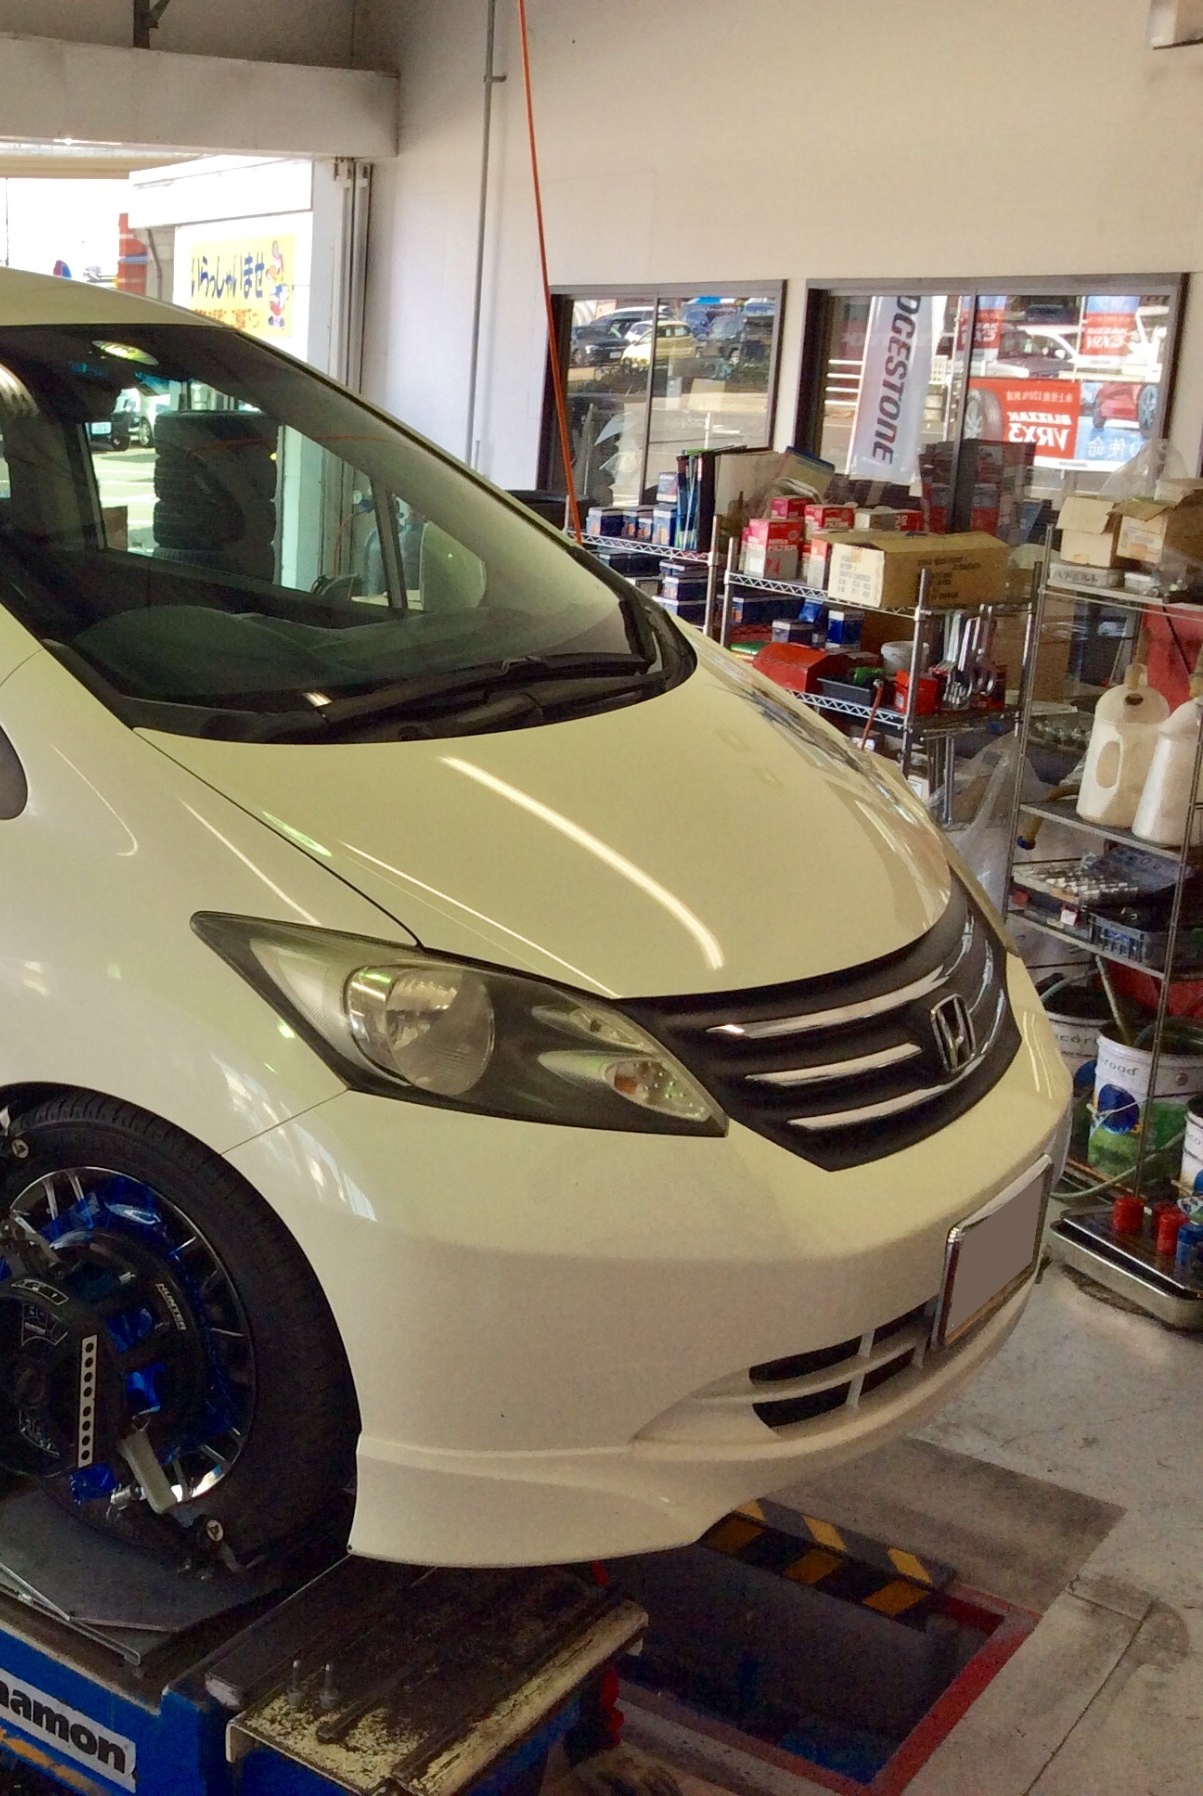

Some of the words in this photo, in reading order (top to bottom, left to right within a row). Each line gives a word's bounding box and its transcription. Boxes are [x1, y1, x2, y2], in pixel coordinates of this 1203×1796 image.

[191, 252, 265, 299] いらっしゃいませ
